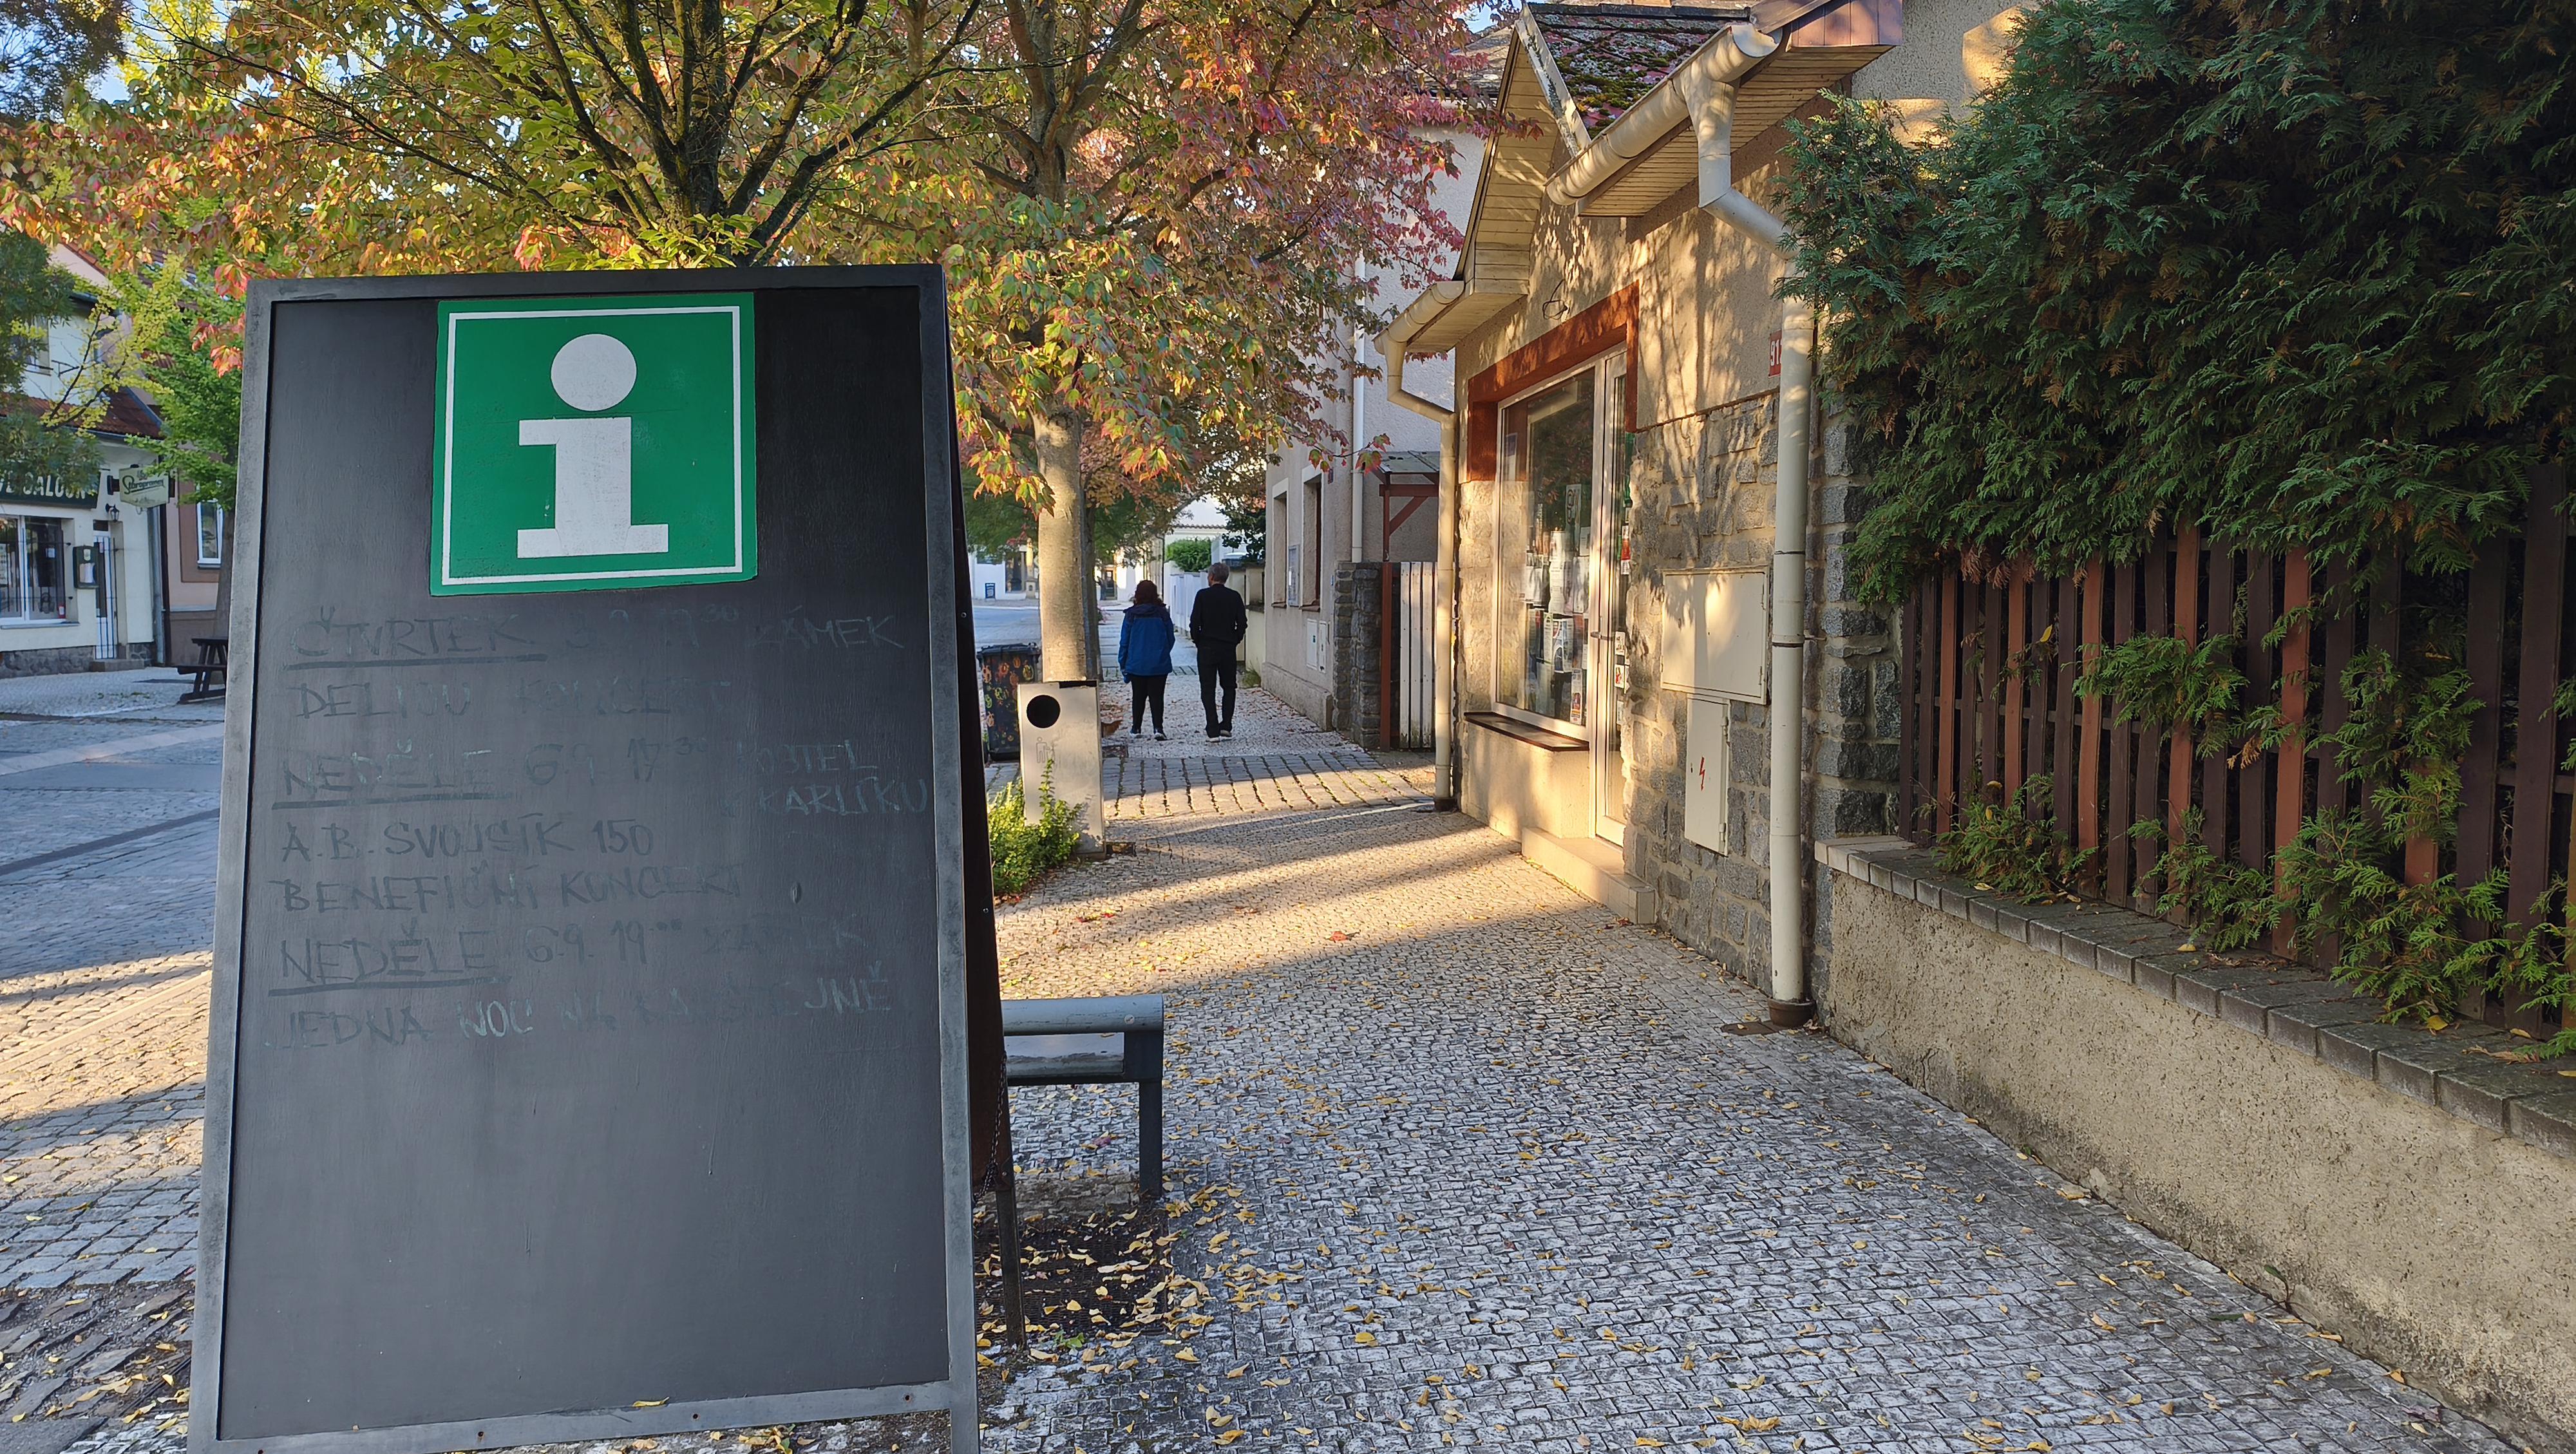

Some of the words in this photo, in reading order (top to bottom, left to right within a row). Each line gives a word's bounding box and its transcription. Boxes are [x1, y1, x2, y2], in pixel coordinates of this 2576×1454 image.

[1770, 339, 1782, 366] 91
[291, 605, 538, 657] ČTVRTEK
[283, 735, 494, 795] NEDĚLE
[591, 818, 654, 855] 150
[281, 916, 499, 984] NEDĚLE
[265, 1006, 430, 1047] JEDNA
[455, 999, 533, 1039] NOC
